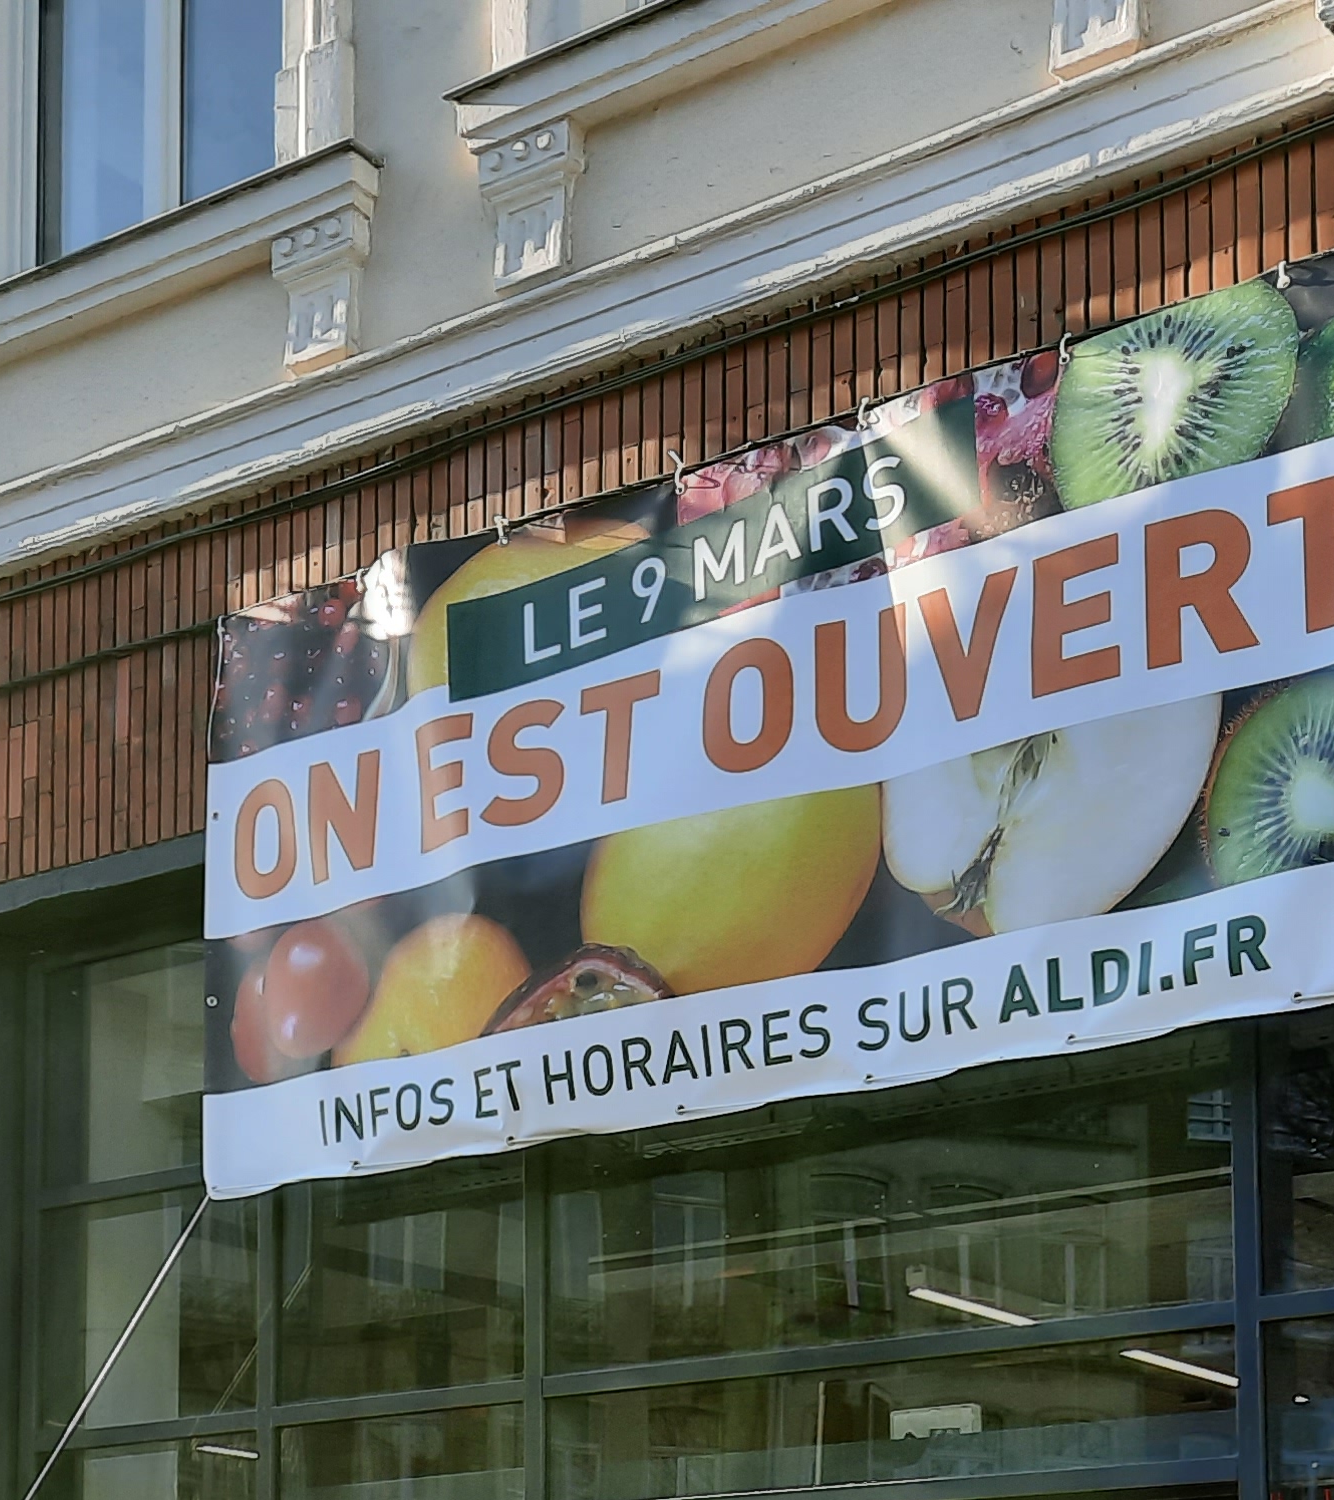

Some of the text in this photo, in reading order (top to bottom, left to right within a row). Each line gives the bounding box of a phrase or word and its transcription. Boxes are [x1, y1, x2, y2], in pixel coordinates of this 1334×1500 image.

[523, 455, 911, 664] LE 9 MARS
[233, 749, 381, 899] ON
[416, 670, 661, 854] EST
[318, 914, 1271, 1146] INFOS ET HORAIRES SUR ALDI.FR
